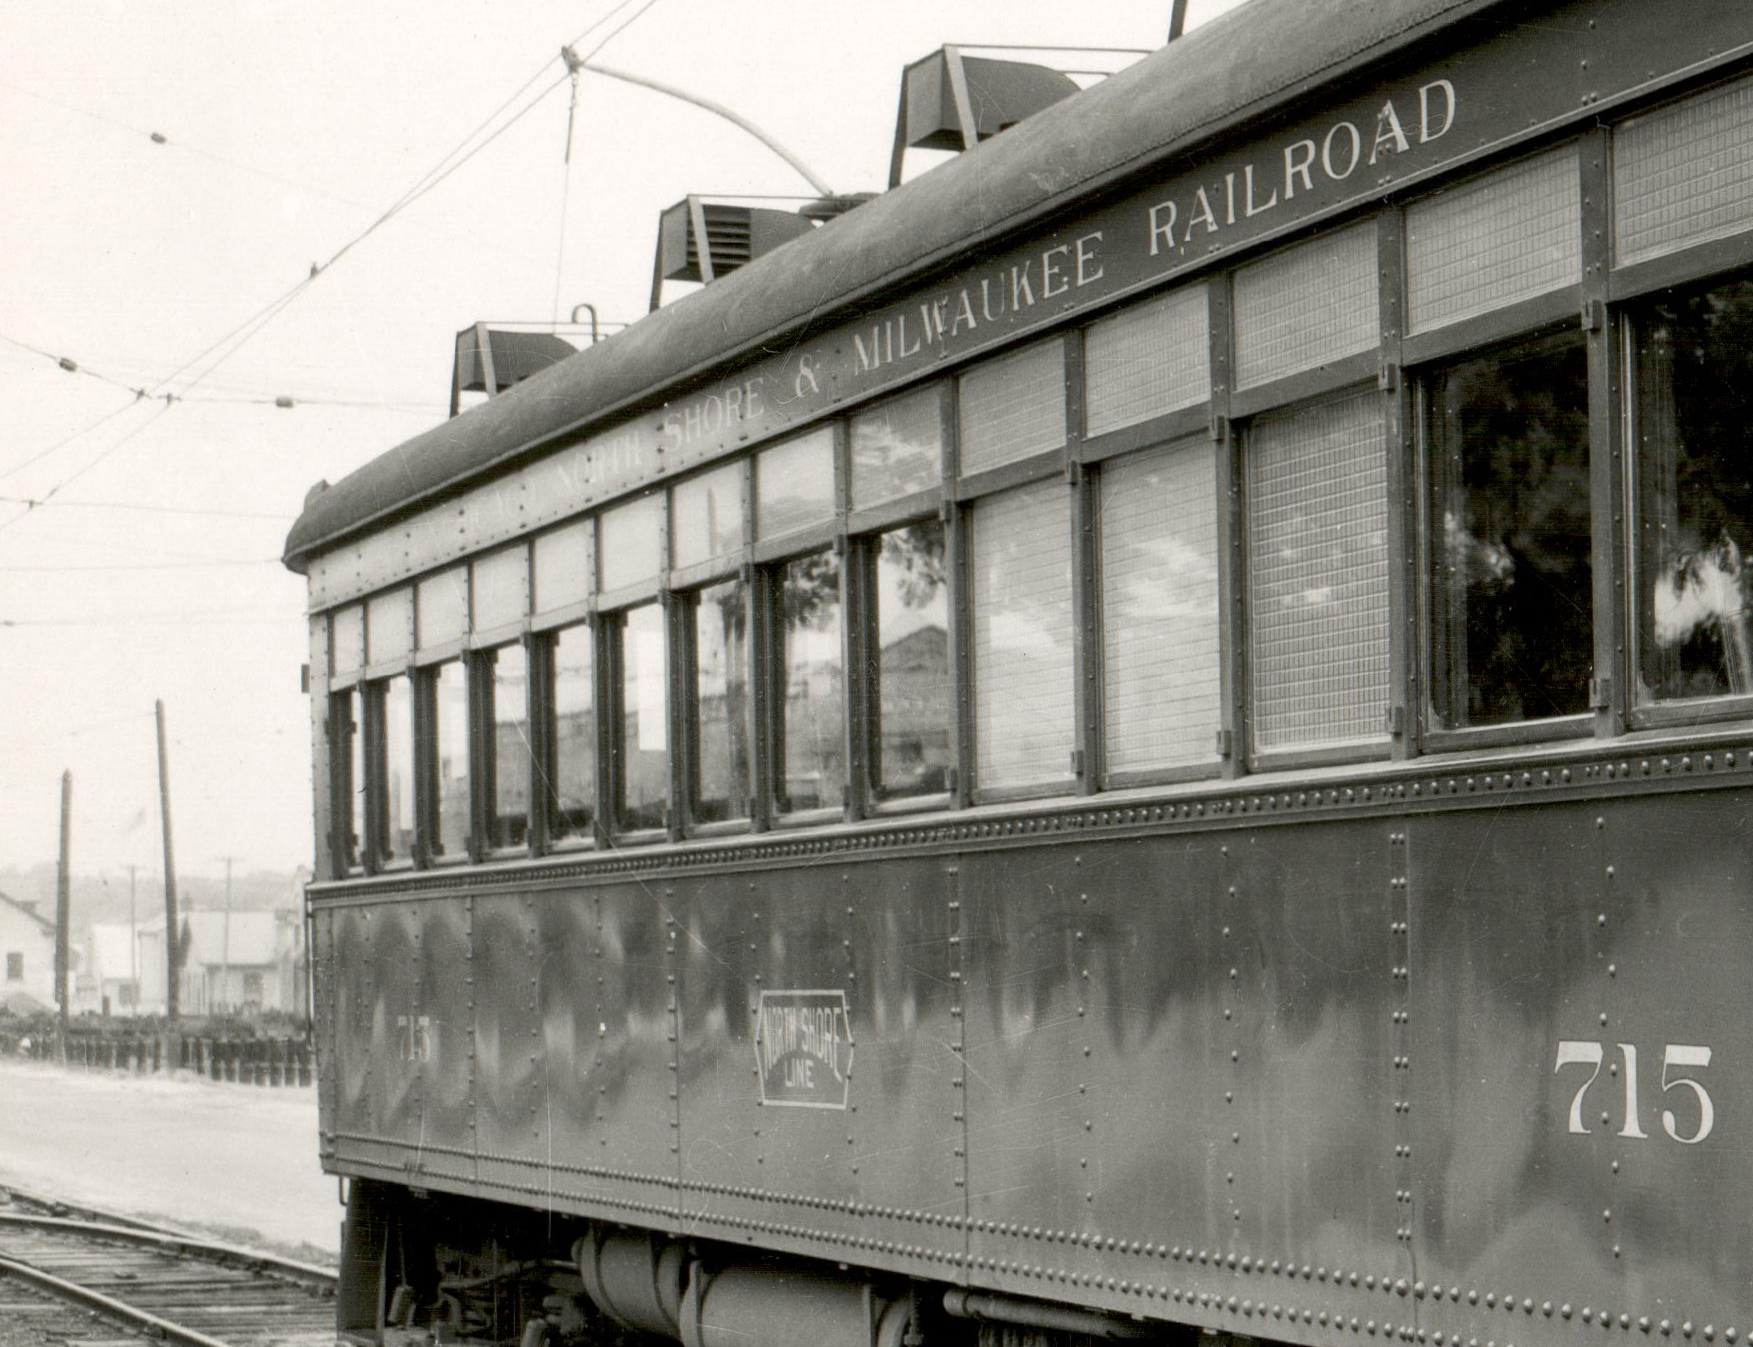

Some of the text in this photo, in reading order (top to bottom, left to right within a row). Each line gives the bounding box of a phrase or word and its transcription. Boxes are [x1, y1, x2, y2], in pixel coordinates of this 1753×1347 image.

[662, 377, 764, 451] SHORE
[795, 354, 821, 398] &
[854, 231, 1104, 376] MILWAUKEE
[1150, 79, 1456, 256] RAILROAD
[397, 1015, 431, 1063] 715
[762, 1006, 843, 1083] NORTH SHORE
[784, 1057, 815, 1088] LINE
[1555, 1040, 1715, 1144] 715
